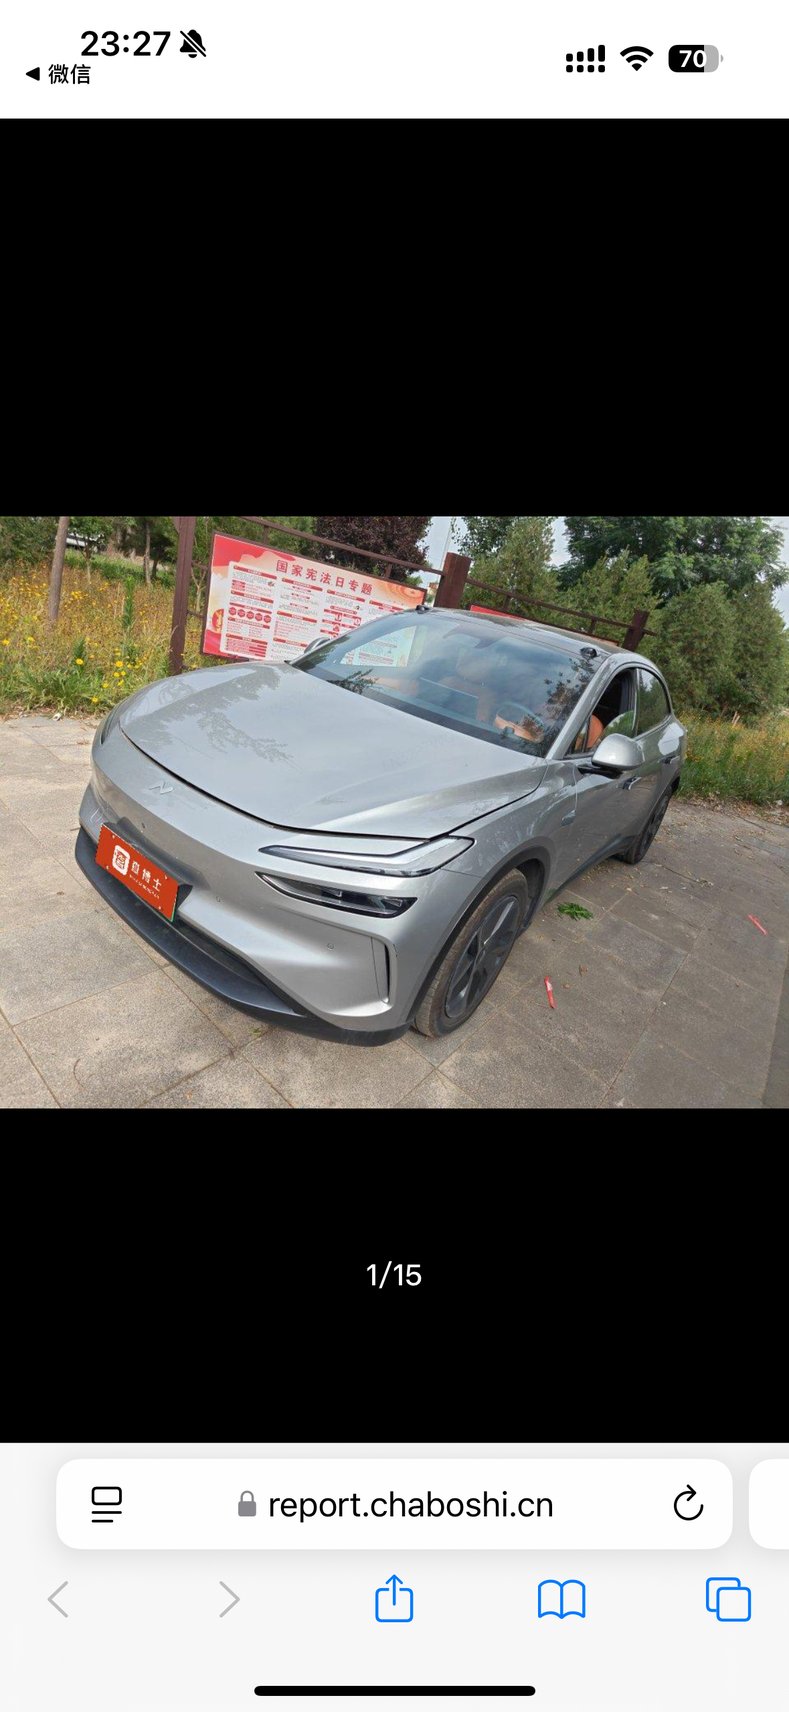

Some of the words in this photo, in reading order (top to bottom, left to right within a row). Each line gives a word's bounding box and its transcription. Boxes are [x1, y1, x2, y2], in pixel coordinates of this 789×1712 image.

[80, 30, 171, 57] 23:27
[679, 49, 708, 68] 70
[48, 63, 92, 85] 微信
[276, 560, 374, 596] 国家宪法日专题
[366, 1260, 422, 1289] 1/15
[269, 1490, 553, 1524] report.chaboshi.cn
